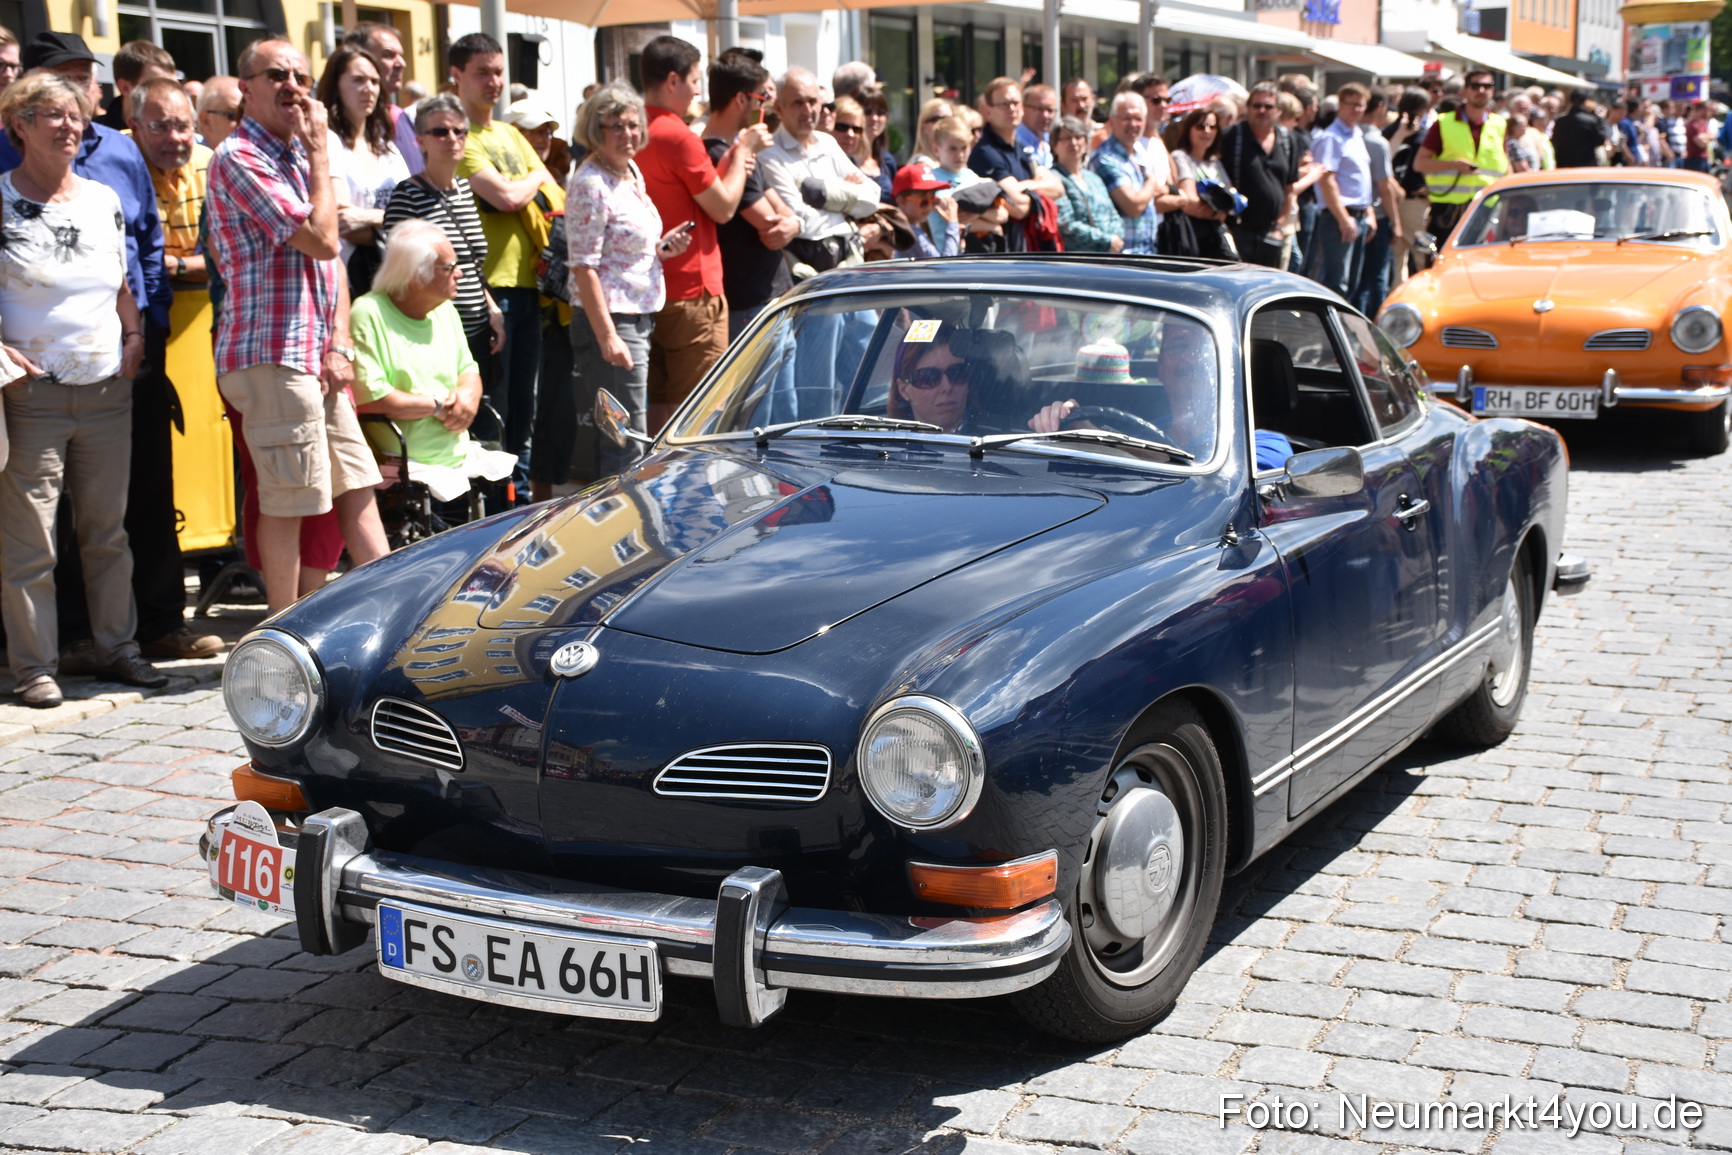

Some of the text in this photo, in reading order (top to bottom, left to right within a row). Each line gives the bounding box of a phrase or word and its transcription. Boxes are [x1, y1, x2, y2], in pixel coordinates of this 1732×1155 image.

[1486, 390, 1596, 411] RH BF 60H
[225, 838, 274, 897] 116
[388, 942, 397, 957] D
[404, 918, 651, 1003] FS EA 66H
